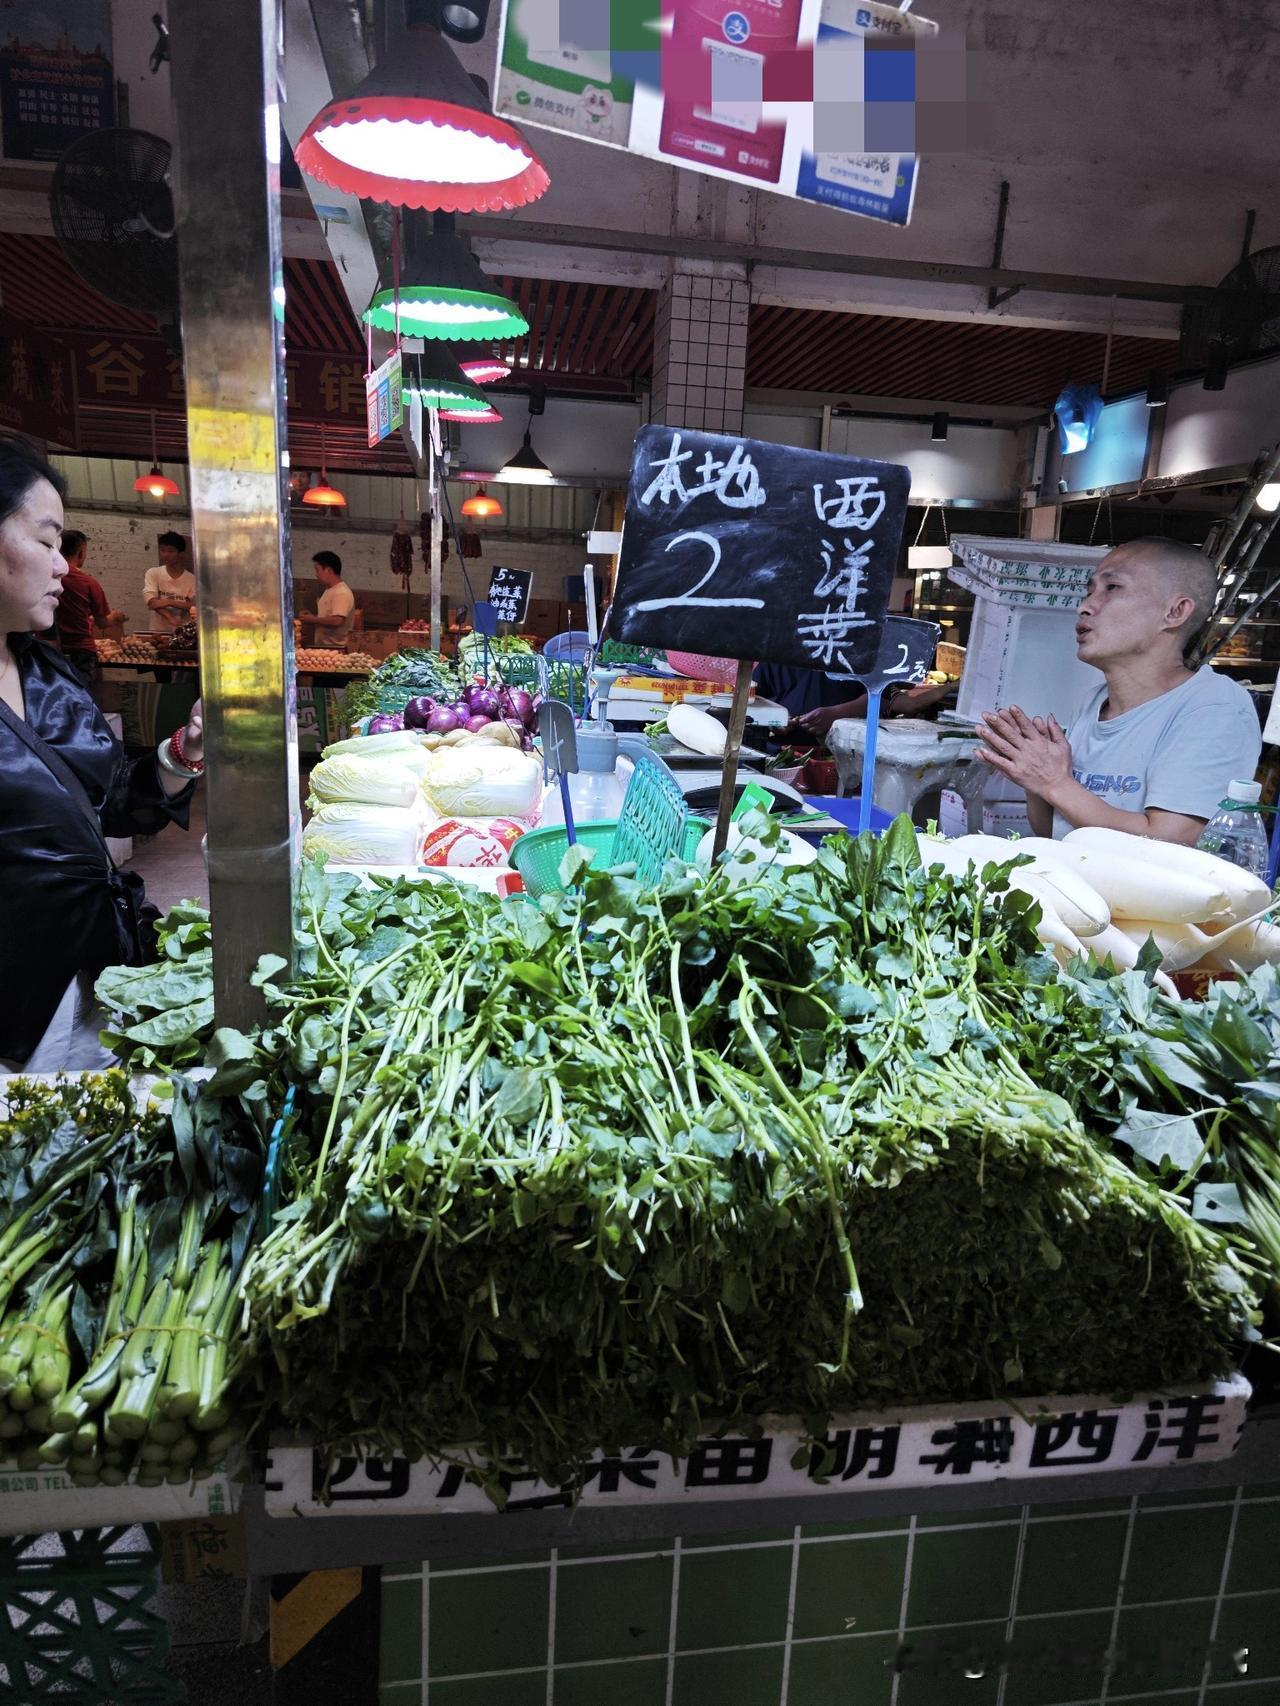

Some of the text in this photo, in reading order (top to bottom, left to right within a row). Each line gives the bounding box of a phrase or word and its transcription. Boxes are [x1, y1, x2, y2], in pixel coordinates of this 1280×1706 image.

[872, 15, 903, 35] 支付宝
[534, 96, 576, 118] 微信支付
[640, 433, 767, 508] 本地
[637, 531, 765, 611] 2
